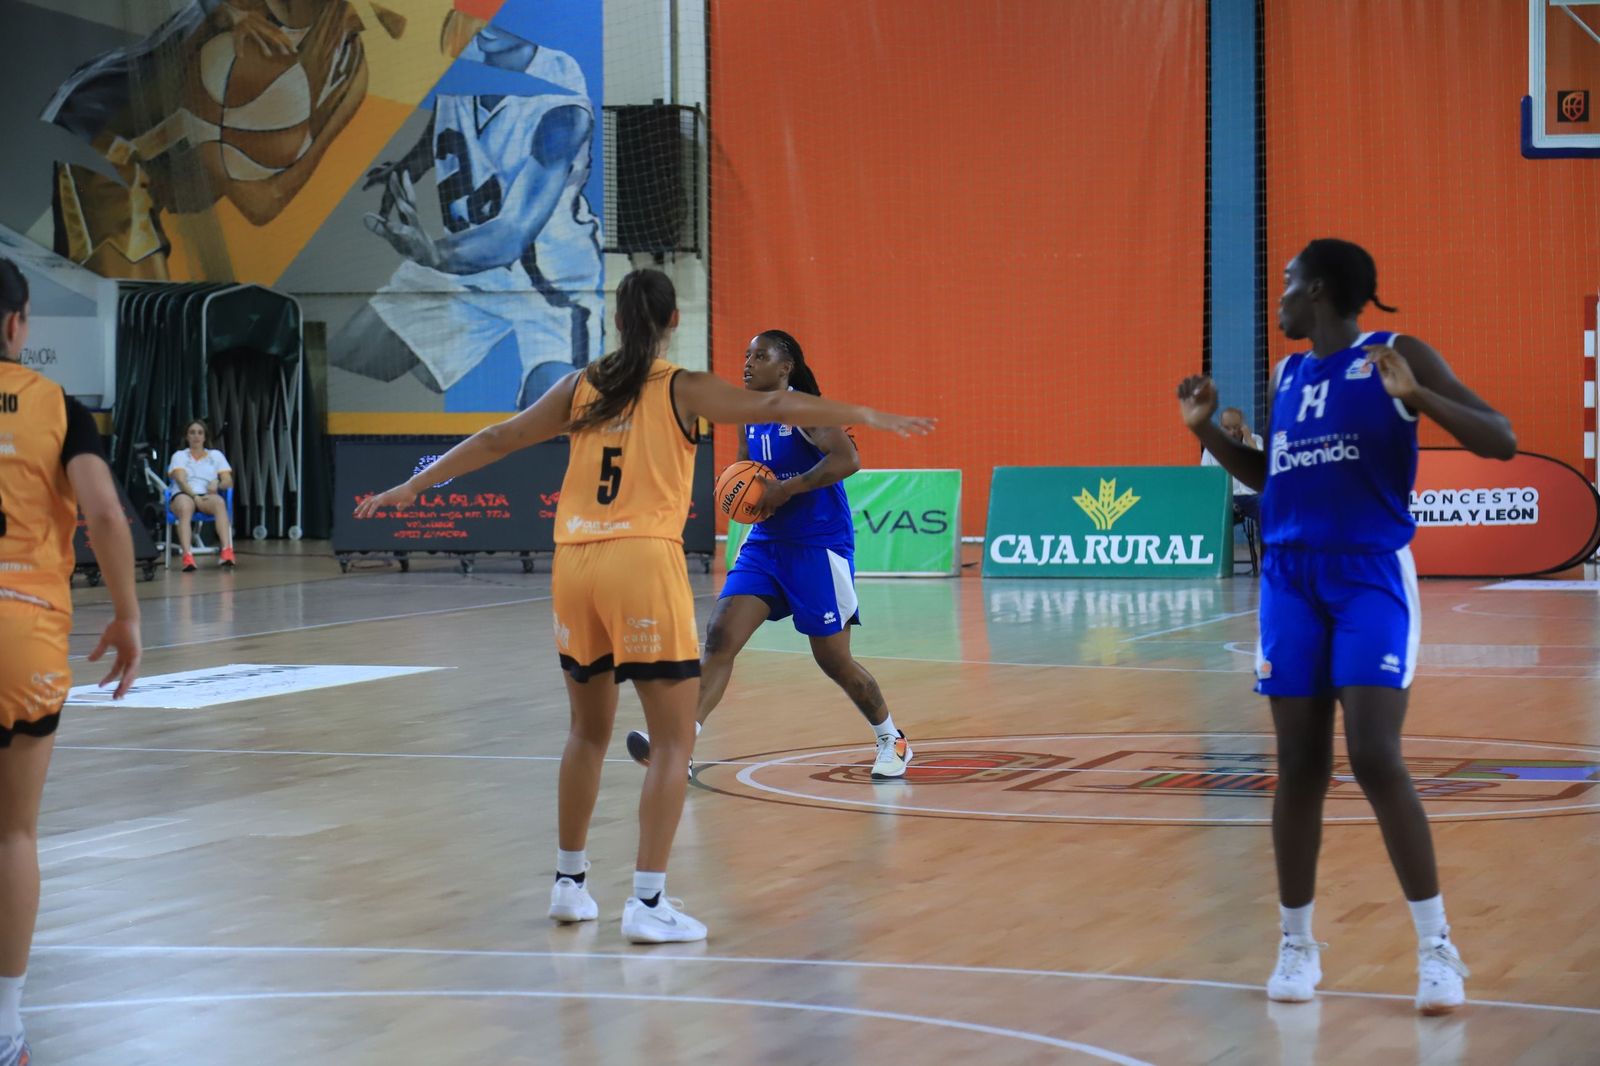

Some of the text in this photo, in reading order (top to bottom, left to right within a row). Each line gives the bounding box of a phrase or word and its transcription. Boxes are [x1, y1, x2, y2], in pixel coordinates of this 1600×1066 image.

[1297, 379, 1329, 422] 14
[760, 433, 772, 460] 11
[597, 446, 622, 505] 5
[722, 479, 746, 515] Wilson
[1409, 505, 1534, 522] TILLA Y LEÓN
[990, 534, 1213, 565] CAJA RURAL
